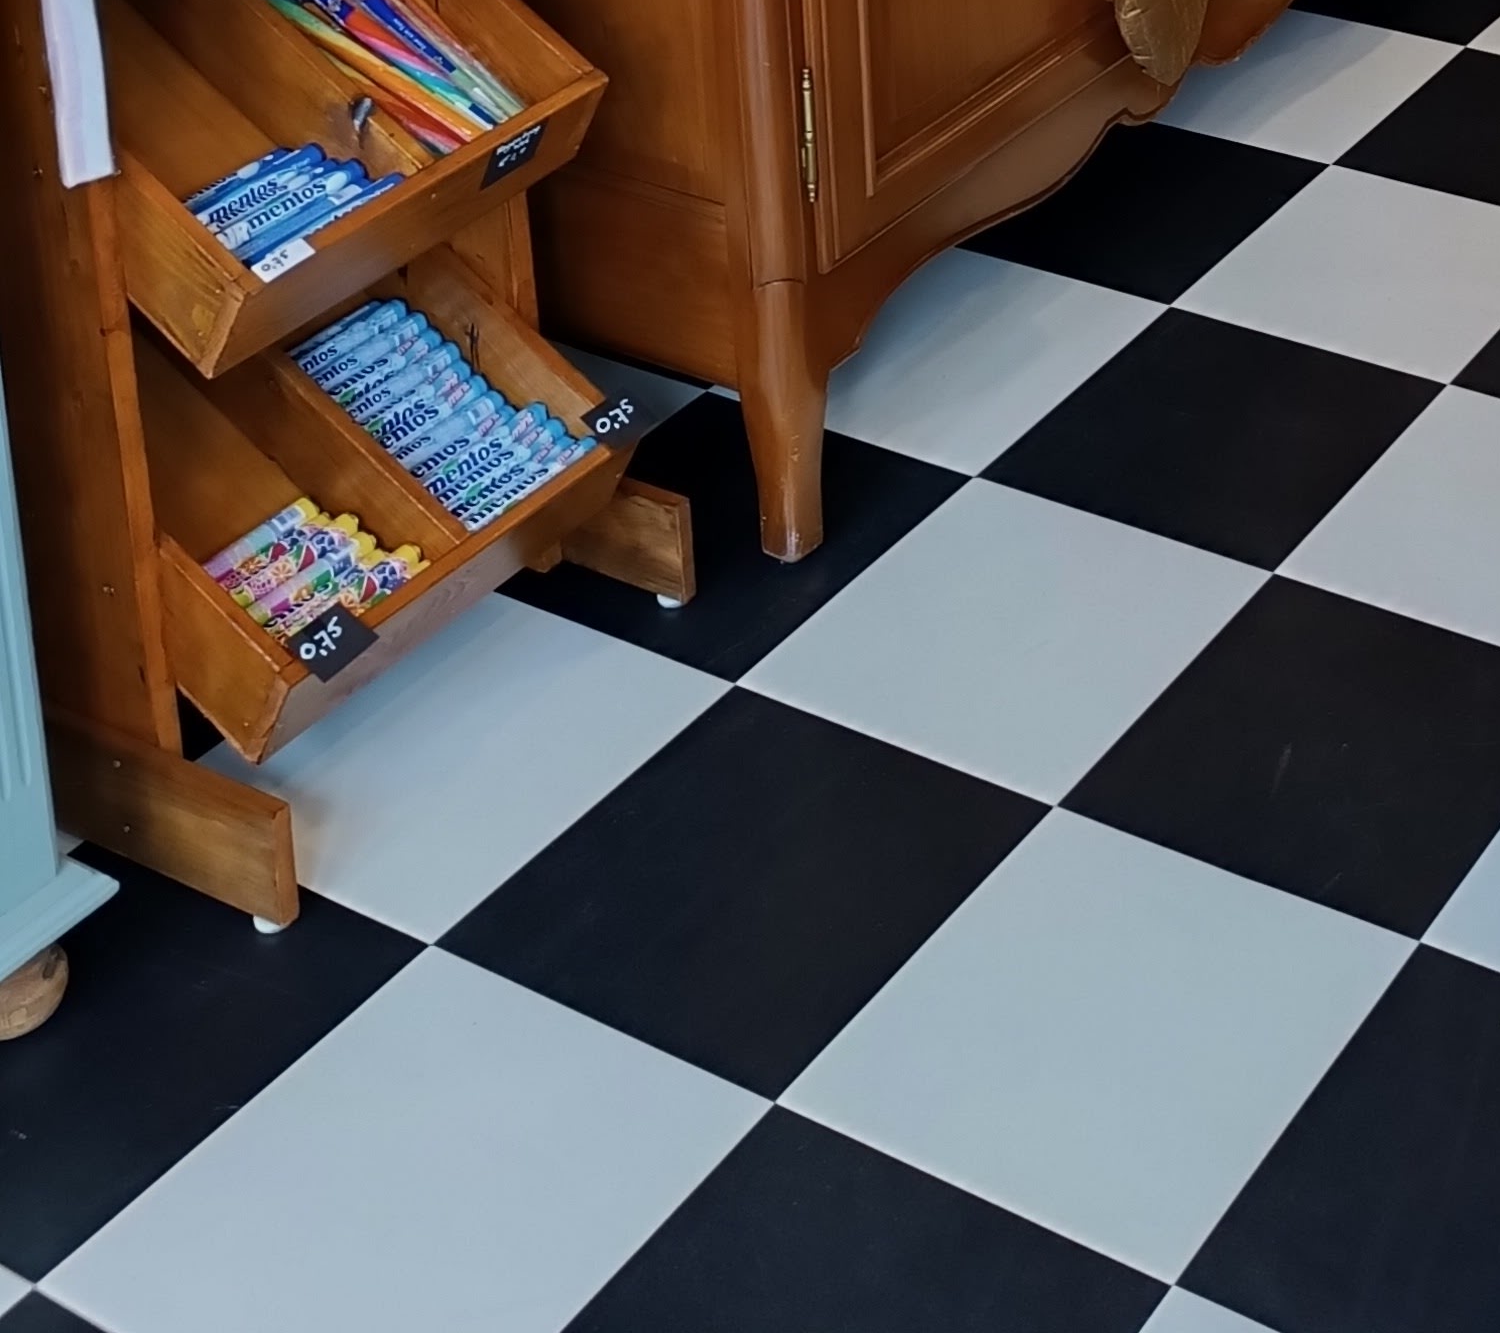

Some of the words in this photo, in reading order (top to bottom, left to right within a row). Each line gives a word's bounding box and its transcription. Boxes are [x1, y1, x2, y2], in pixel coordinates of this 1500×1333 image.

[249, 179, 327, 230] mentos
[301, 343, 339, 373] ntos
[314, 354, 359, 385] entos
[348, 387, 392, 420] entos
[594, 397, 635, 436] 0,75
[379, 405, 440, 450] entos
[410, 435, 471, 479] entos
[427, 437, 504, 495] mentos
[299, 615, 344, 661] 0,75
